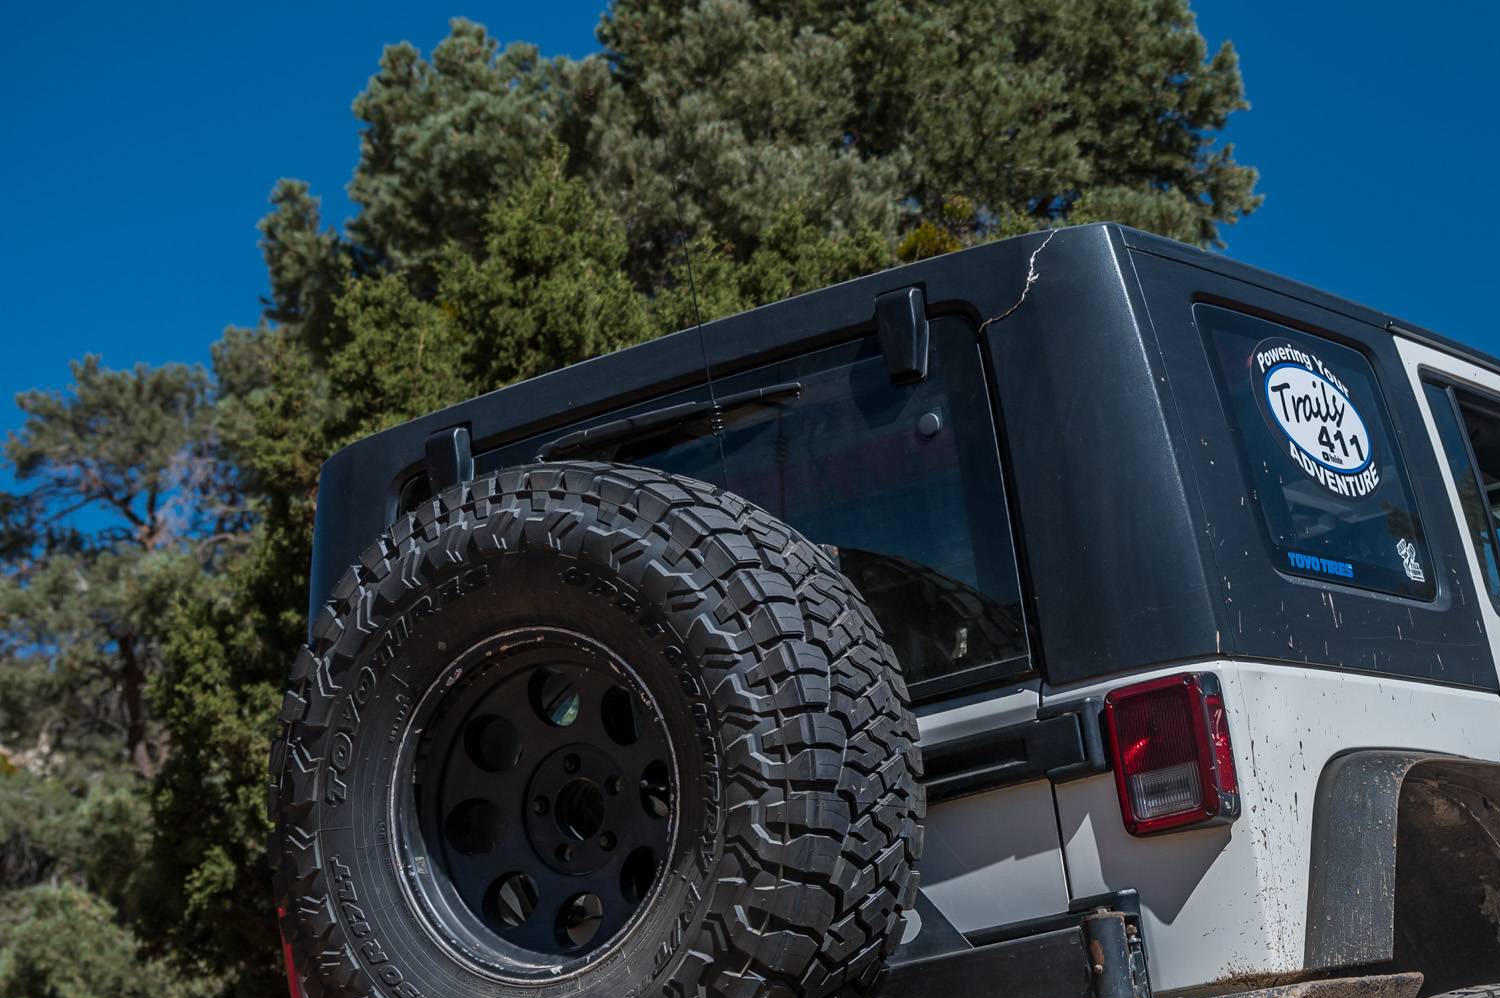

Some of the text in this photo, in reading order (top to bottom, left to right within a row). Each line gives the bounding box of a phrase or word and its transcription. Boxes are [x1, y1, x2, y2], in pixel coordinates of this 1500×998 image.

[1257, 343, 1349, 398] Powering Your
[1271, 380, 1345, 427] Trails
[1289, 440, 1380, 497] ADVENTURE
[1318, 425, 1364, 462] 411
[1287, 551, 1354, 578] TOYO TIRES
[326, 660, 376, 806] TOYO
